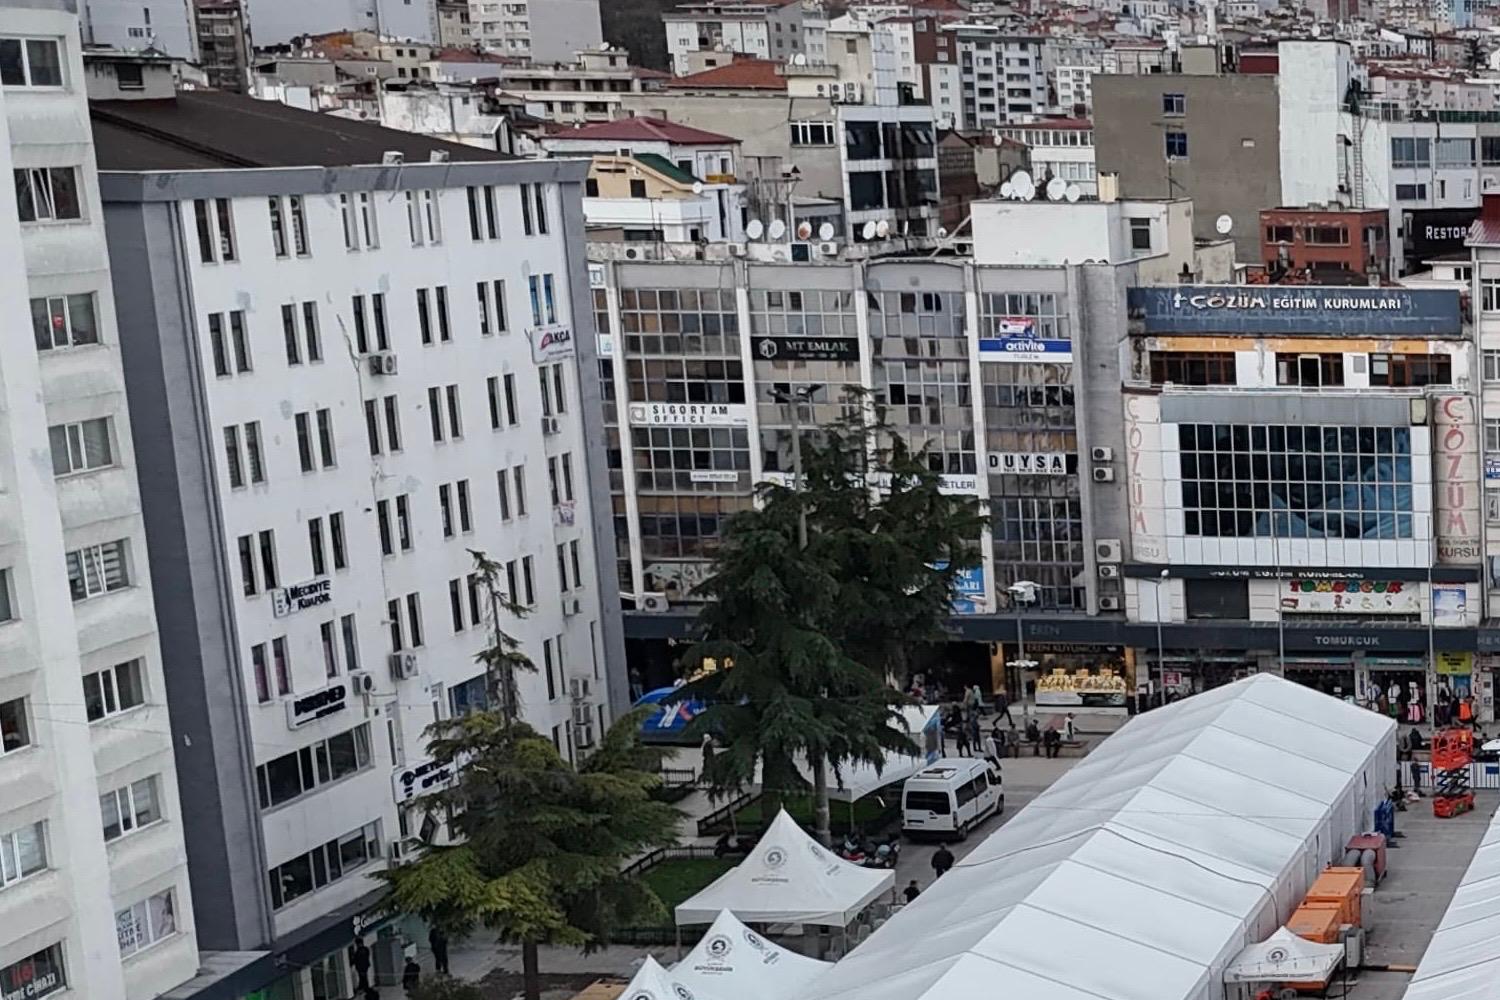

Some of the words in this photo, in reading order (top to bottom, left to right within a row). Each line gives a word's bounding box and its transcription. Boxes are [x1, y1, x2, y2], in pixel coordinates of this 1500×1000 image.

[1273, 294, 1317, 309] EĞİTİM
[1324, 298, 1401, 310] KURUMLARI
[989, 454, 1062, 469] DUYSA
[1315, 636, 1380, 646] TOMURCUK
